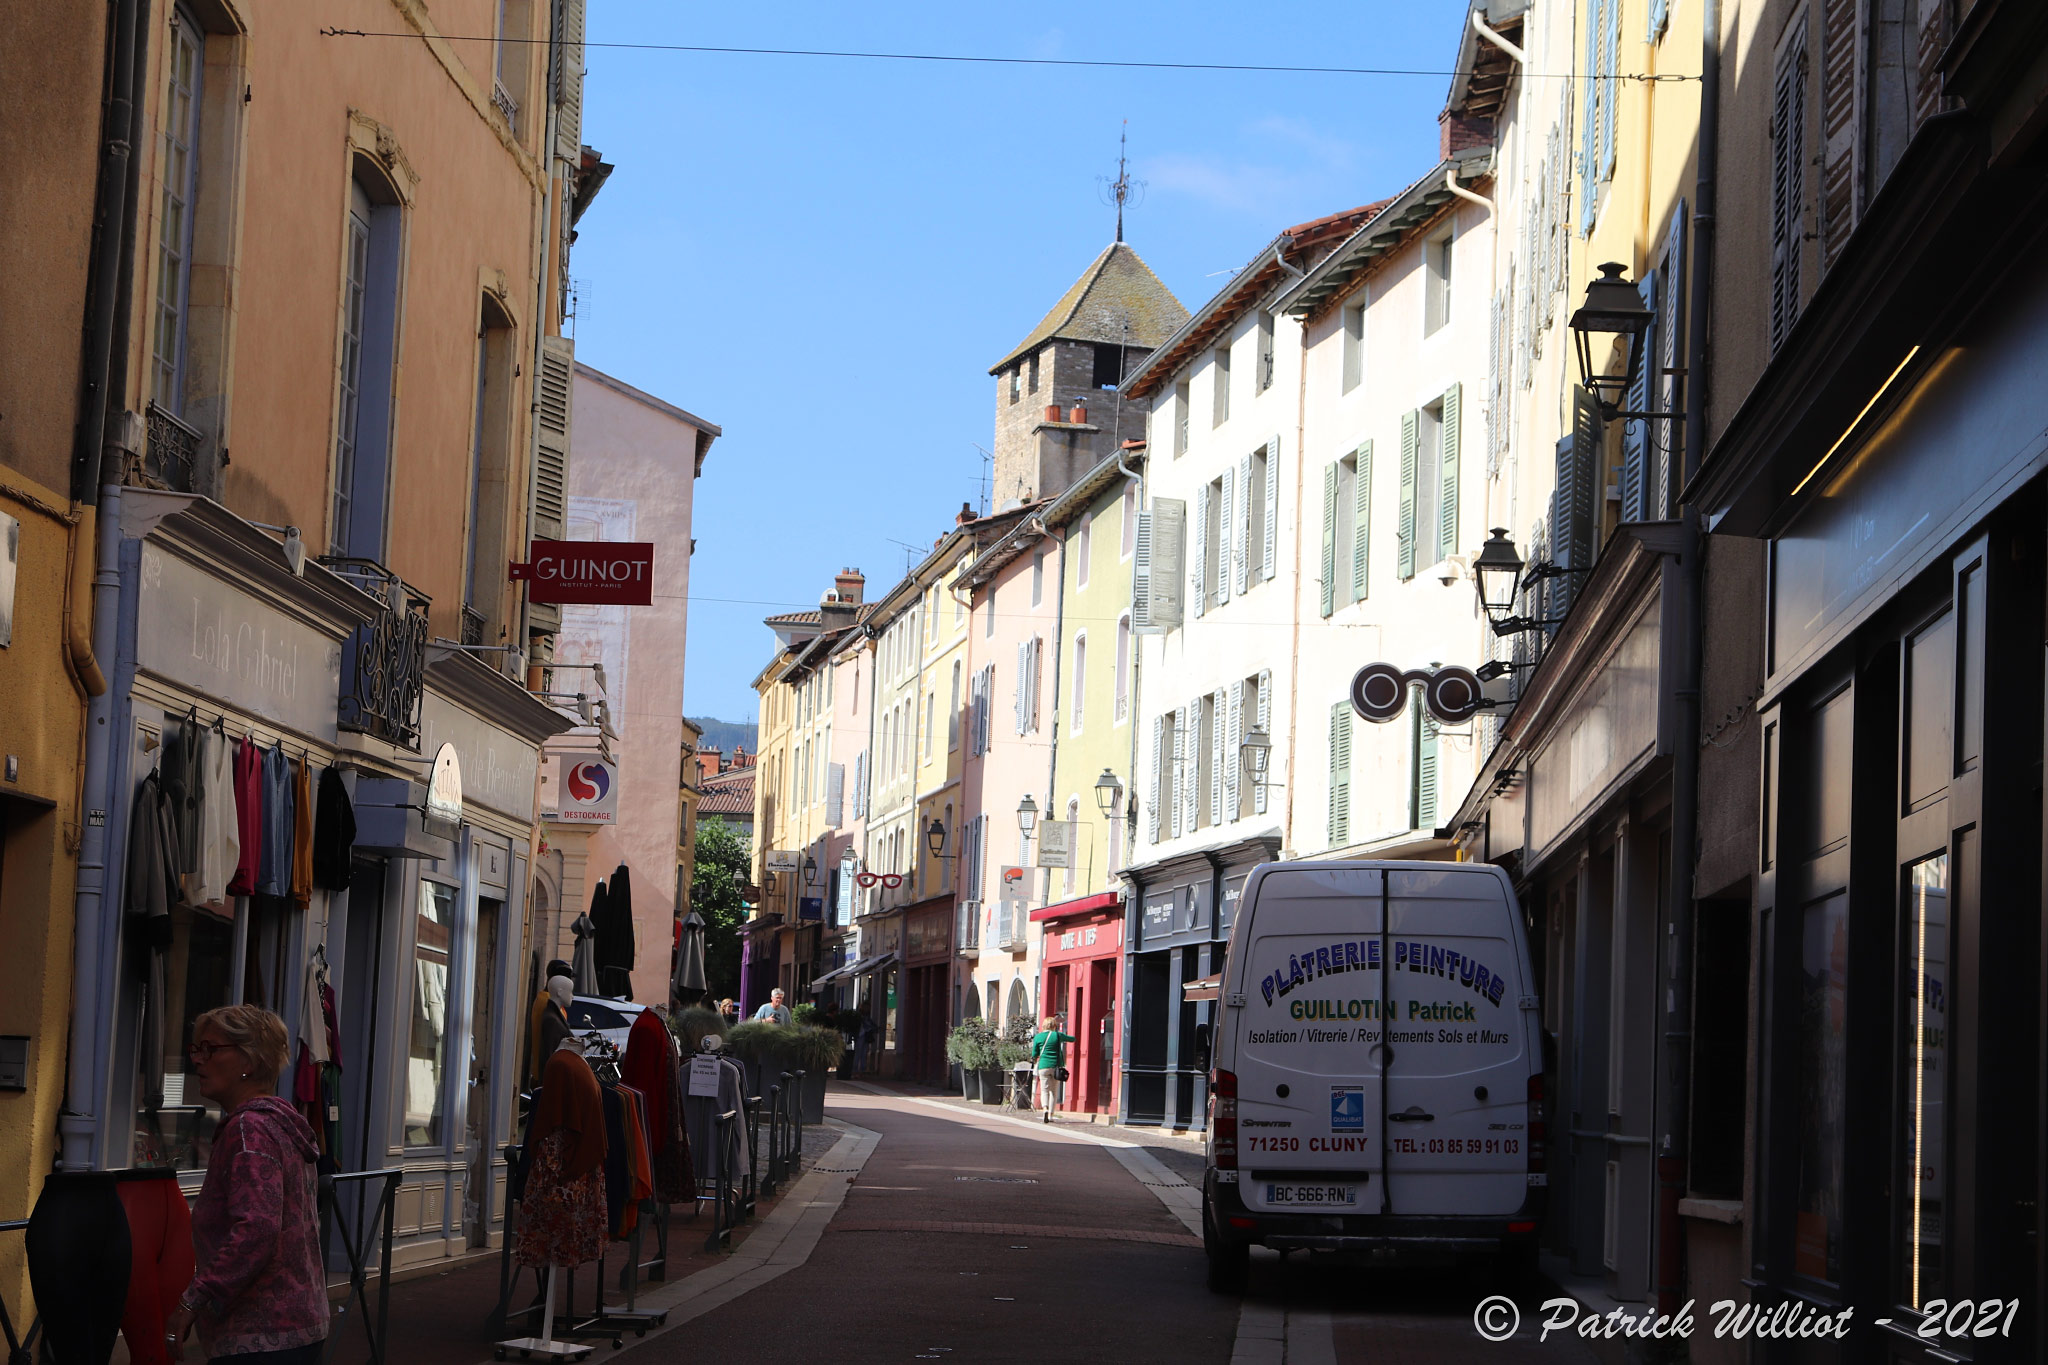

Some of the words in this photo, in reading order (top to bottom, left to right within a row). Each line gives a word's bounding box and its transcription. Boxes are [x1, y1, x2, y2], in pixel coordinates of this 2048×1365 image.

[536, 556, 648, 582] GUINOT
[191, 597, 231, 673] Lola
[236, 622, 298, 701] Gabriel
[564, 811, 611, 820] DESTOCKAGE
[1261, 940, 1381, 1008] PLÂTRERIE
[1395, 941, 1505, 1009] PEINTURE
[1290, 999, 1398, 1022] GUILLOTIN
[1408, 1000, 1477, 1023] Patrick
[1248, 1029, 1297, 1044] Isolation
[1307, 1028, 1348, 1043] Vitrerie
[1357, 1028, 1434, 1043] Revtements
[1437, 1028, 1464, 1043] Sols
[1466, 1030, 1479, 1043] et
[1480, 1029, 1509, 1044] Murs
[1248, 1137, 1300, 1152] 71250
[1309, 1137, 1369, 1152] CLUNY
[1394, 1138, 1418, 1153] TEL
[1429, 1139, 1444, 1153] 03
[1447, 1139, 1463, 1153] 85
[1467, 1139, 1483, 1153] 59
[1486, 1139, 1500, 1153] 91
[1504, 1140, 1519, 1153] 03
[1275, 1186, 1346, 1202] BC-666-RN
